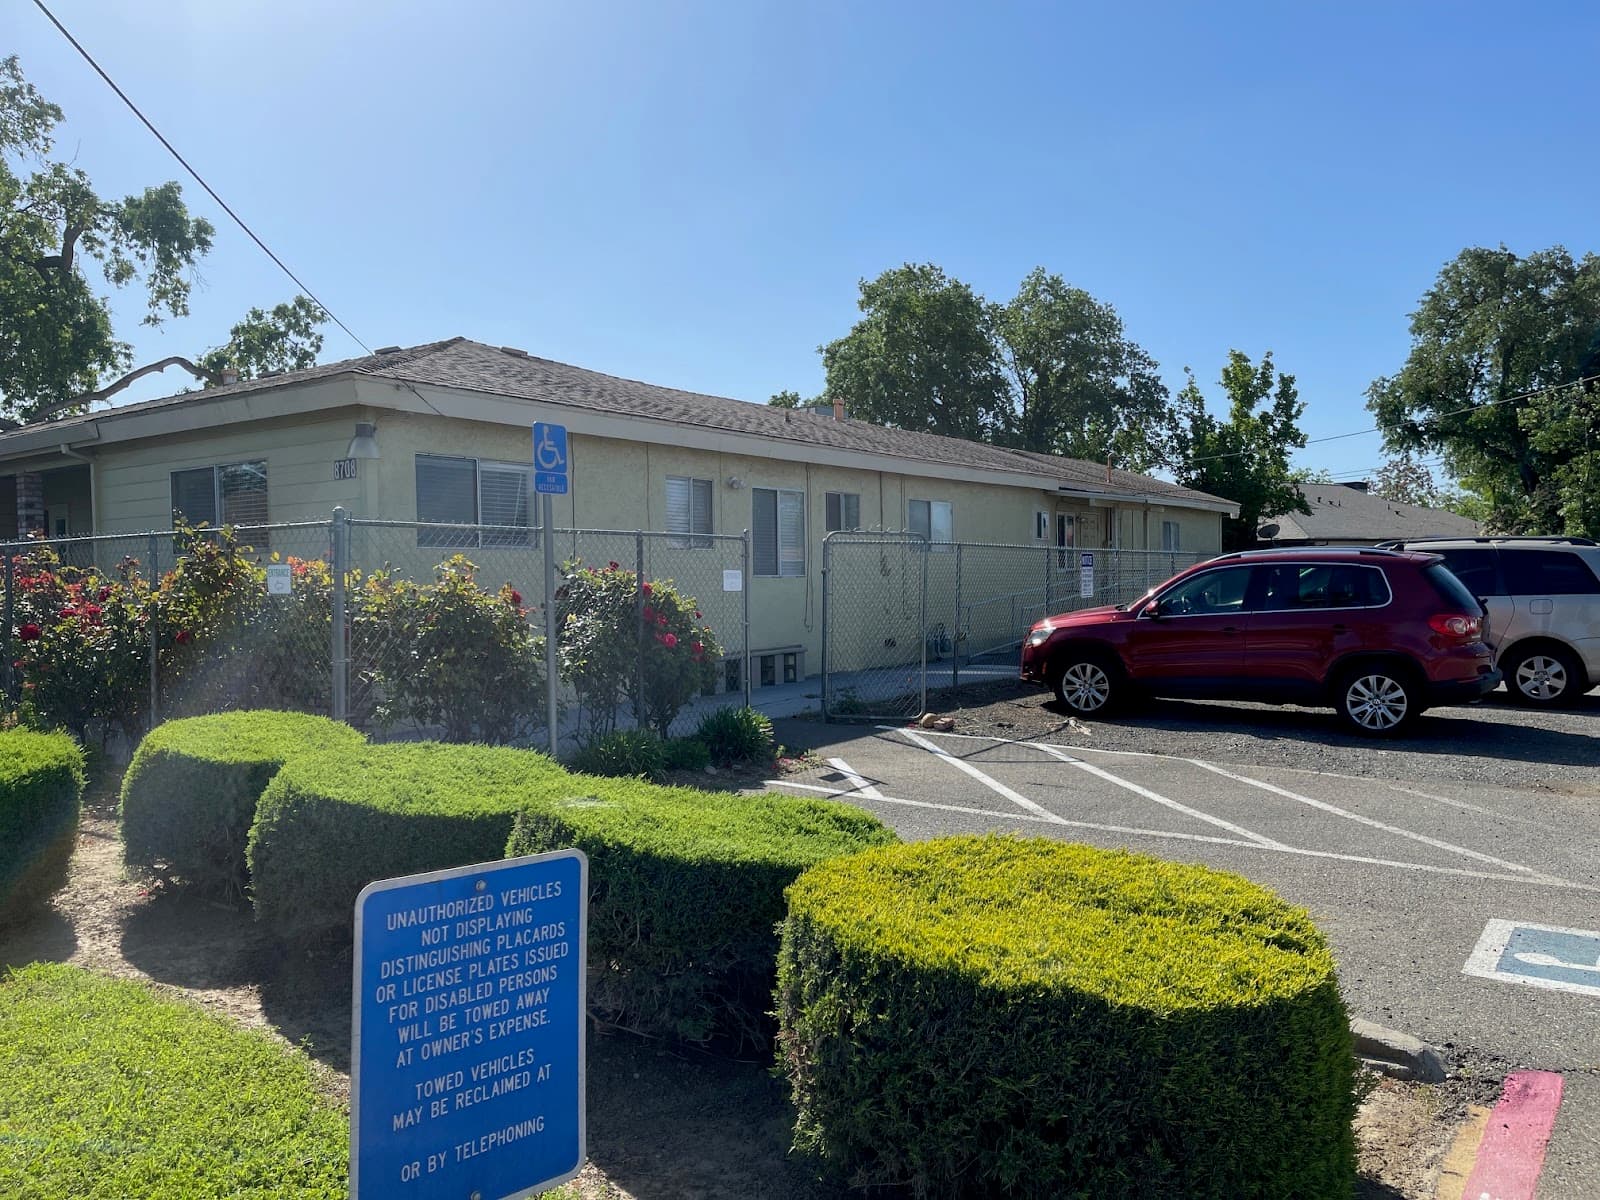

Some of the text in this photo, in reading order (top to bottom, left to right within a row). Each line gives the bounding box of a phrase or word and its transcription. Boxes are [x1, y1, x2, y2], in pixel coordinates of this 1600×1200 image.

[335, 460, 356, 479] 8708
[387, 881, 562, 931] UNAUTHORIZED VEHICLES
[421, 908, 533, 947] NOT DISPLAYING
[376, 942, 569, 1003] OR LICENSE PLATES ISSUED
[381, 921, 565, 979] DISTINGUISHING PLACARDS
[389, 965, 558, 1024] FOR DISABLED PERSONS
[398, 987, 550, 1044] WILL BE TOWED AWAY
[396, 1009, 551, 1068] AT OWNER'S EXPENSE.
[393, 1064, 552, 1132] MAY BE RECLAIMED AT
[415, 1048, 535, 1100] TOWED VEHICLES
[401, 1116, 545, 1183] OR BY TELEPHONING
